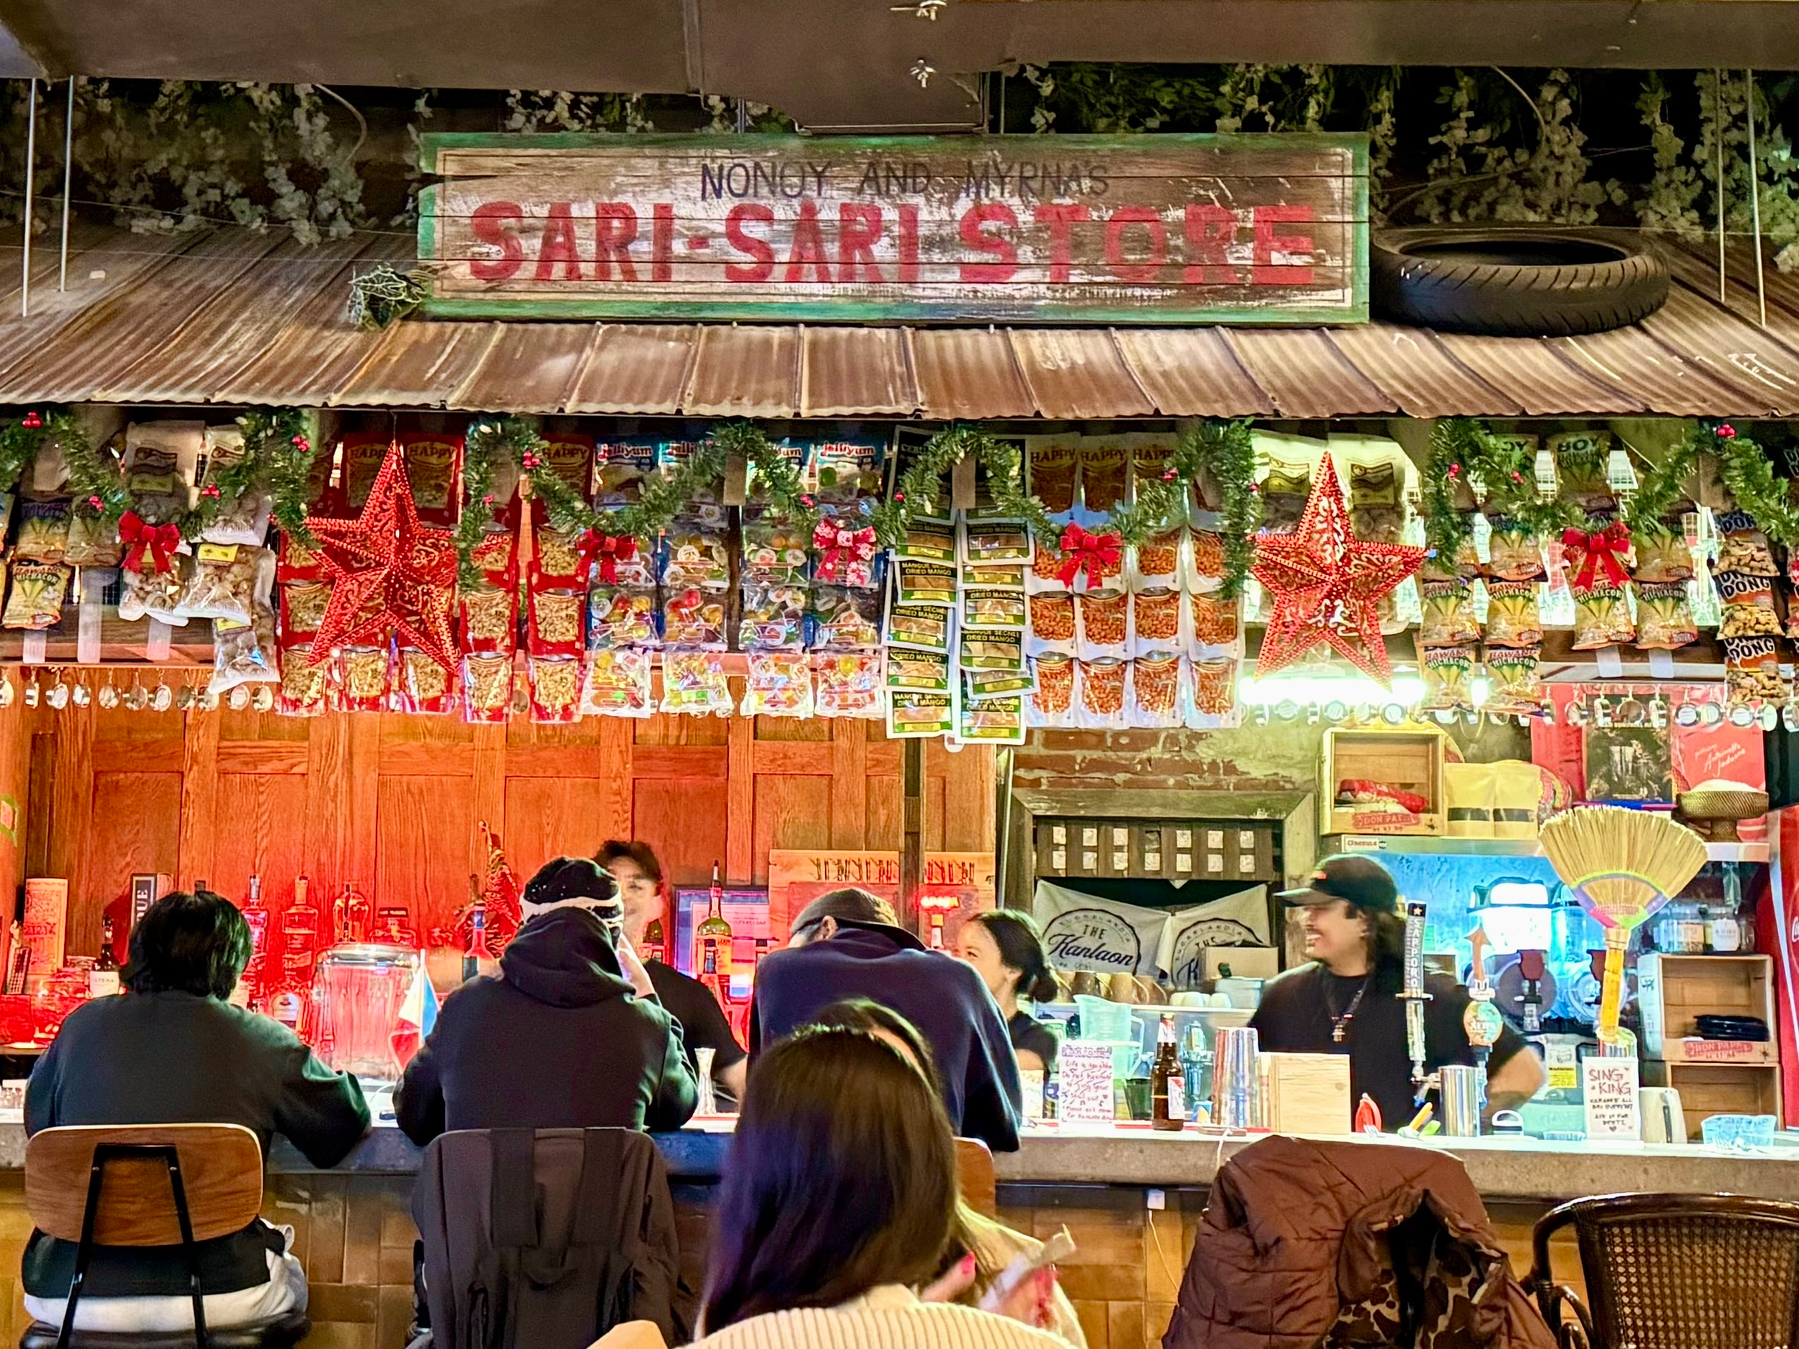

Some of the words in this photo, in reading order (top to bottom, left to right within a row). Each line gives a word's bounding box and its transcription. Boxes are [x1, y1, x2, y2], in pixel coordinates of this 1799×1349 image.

[701, 161, 830, 199] NONOY
[857, 161, 931, 197] AND
[469, 200, 920, 283] SARI-SARI
[959, 203, 1315, 286] STORE
[351, 446, 386, 459] HAPP
[1030, 448, 1077, 463] HAPPY
[1081, 449, 1126, 462] HAPPY
[1133, 448, 1175, 461] HAPP
[1722, 514, 1755, 534] DON
[1722, 577, 1771, 598] DONG
[918, 610, 943, 620] MANGO
[1083, 924, 1108, 940] THE
[1047, 933, 1135, 966] Kanlaon
[1409, 919, 1421, 986] SAPPORO
[1589, 1068, 1623, 1082] SING
[1599, 1082, 1631, 1096] KING
